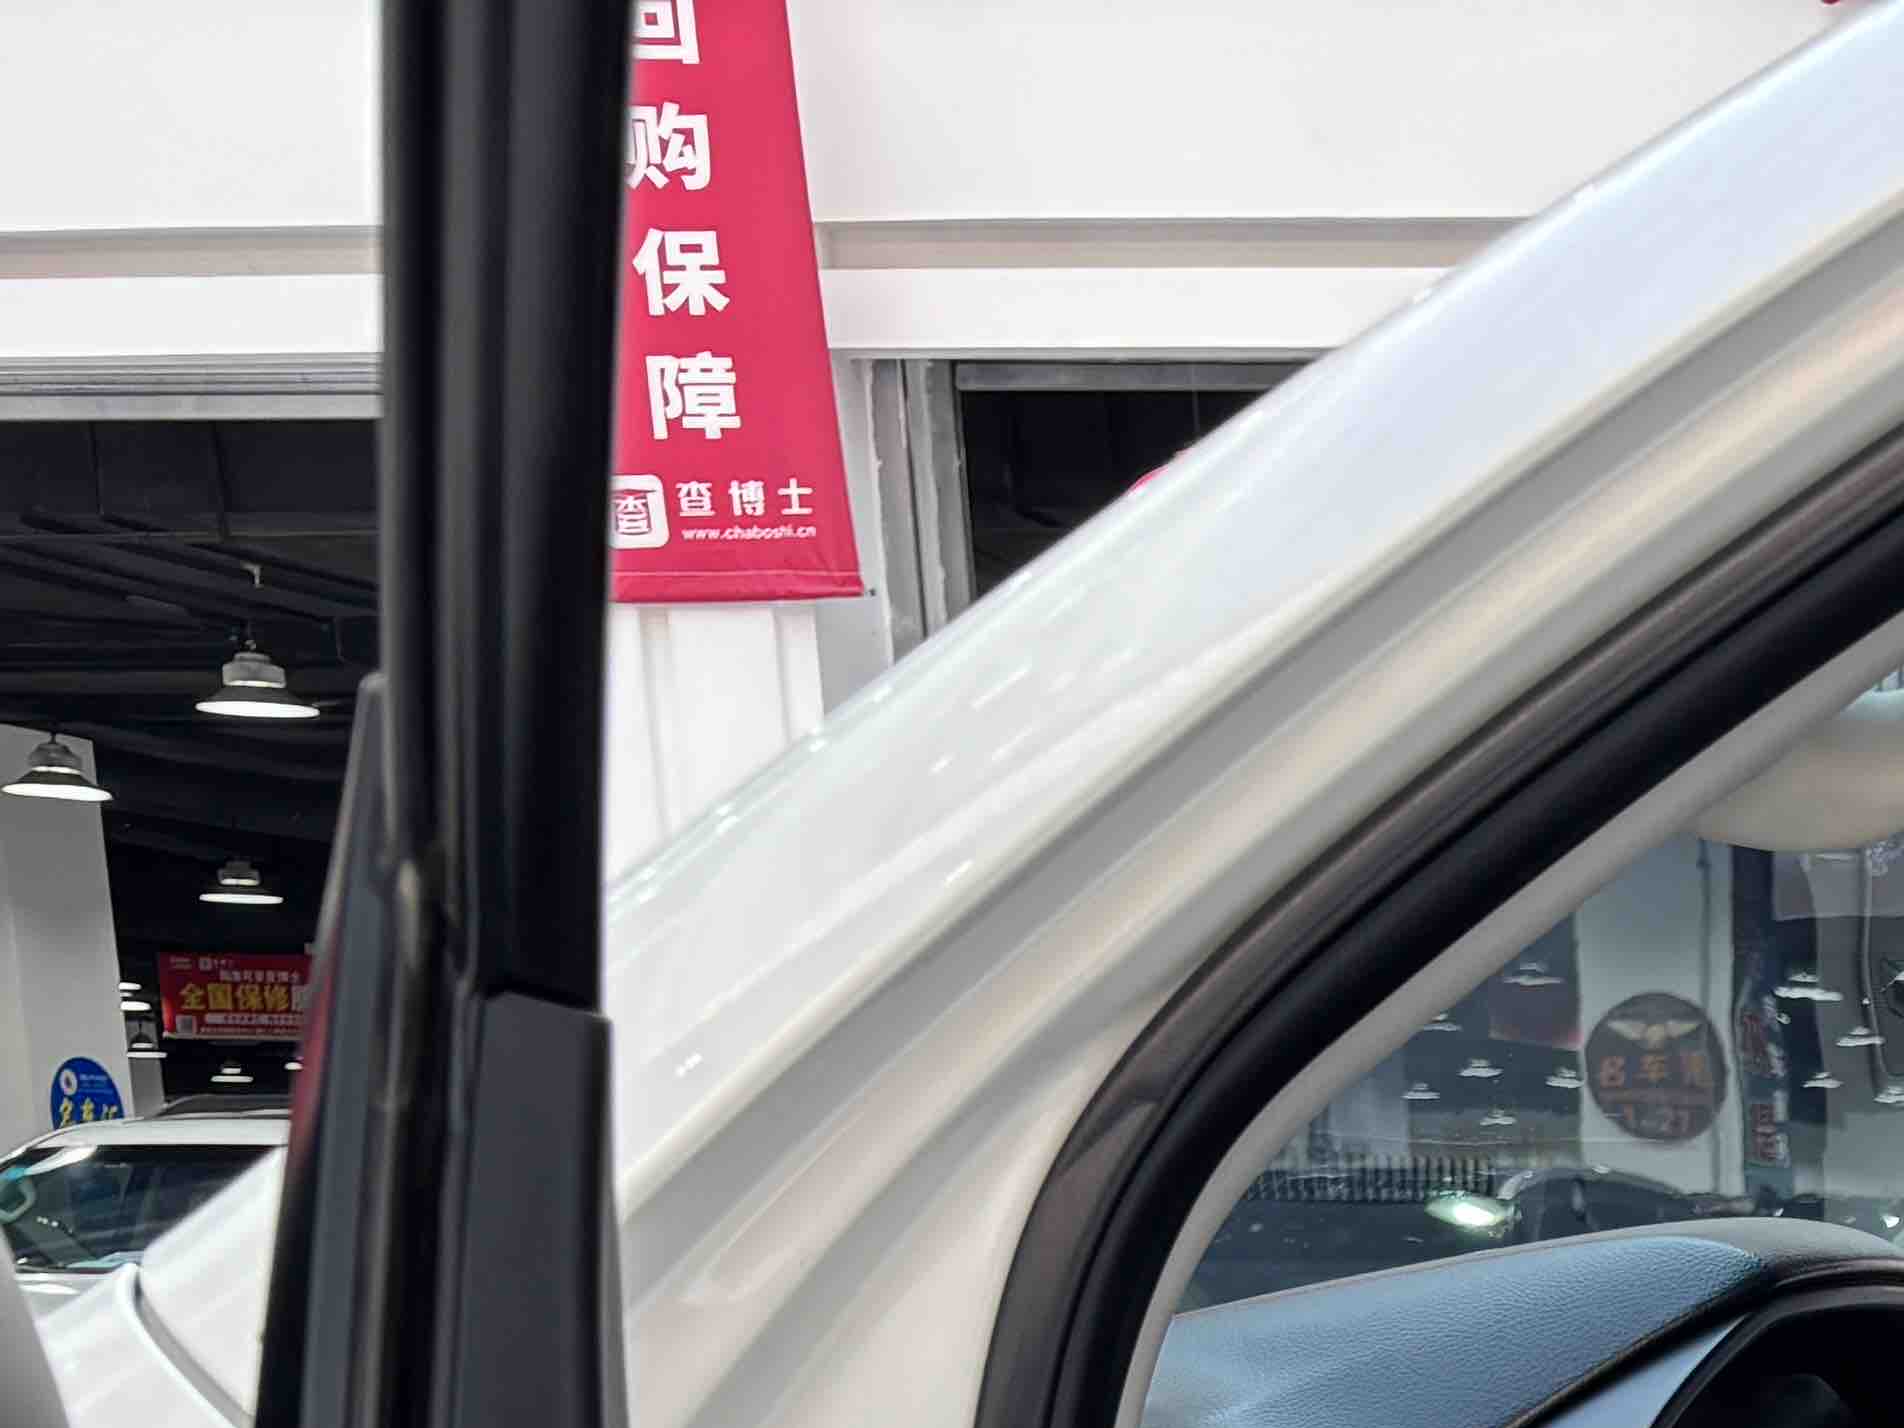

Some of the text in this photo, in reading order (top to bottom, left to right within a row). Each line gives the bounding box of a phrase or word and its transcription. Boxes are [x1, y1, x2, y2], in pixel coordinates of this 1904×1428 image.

[675, 478, 813, 516] 查博士
[681, 525, 816, 540] www.chaboshi.cn
